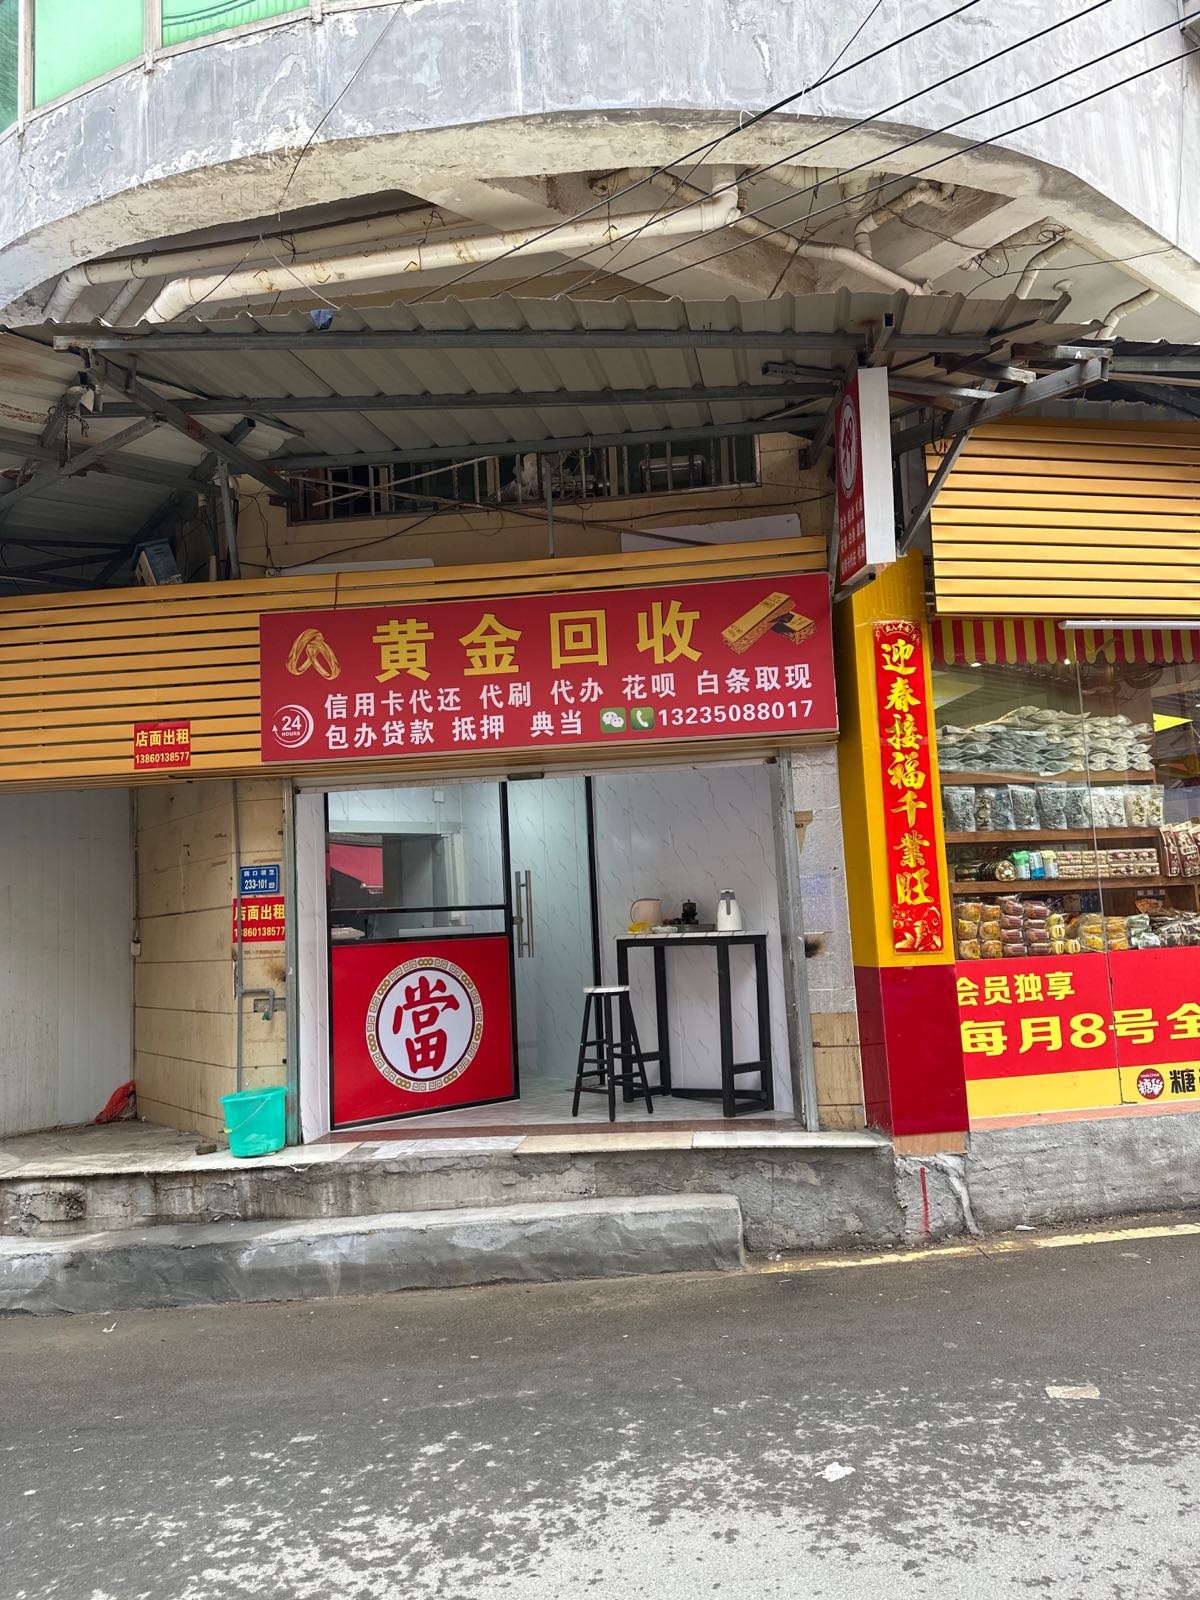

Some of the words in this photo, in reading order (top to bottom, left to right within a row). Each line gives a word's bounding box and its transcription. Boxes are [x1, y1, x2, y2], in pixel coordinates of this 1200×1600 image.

[372, 600, 702, 683] 黄金回收
[324, 687, 462, 719] 信用卡代还
[479, 681, 531, 709] 代刷
[550, 677, 603, 705] 代办
[622, 672, 676, 700] 花呗
[697, 664, 812, 695] 白条取现
[136, 728, 190, 747] 店面出租
[281, 715, 302, 731] 24
[325, 718, 435, 750] 包办贷款
[452, 714, 505, 742] 抵押
[530, 709, 582, 737] 典当
[658, 700, 813, 726] 13235088017
[136, 751, 190, 764] 13860138577
[234, 926, 285, 937] 1860138577
[957, 971, 1076, 1006] 会员独享
[392, 975, 461, 1073] 當
[1169, 1069, 1200, 1094] 糖
